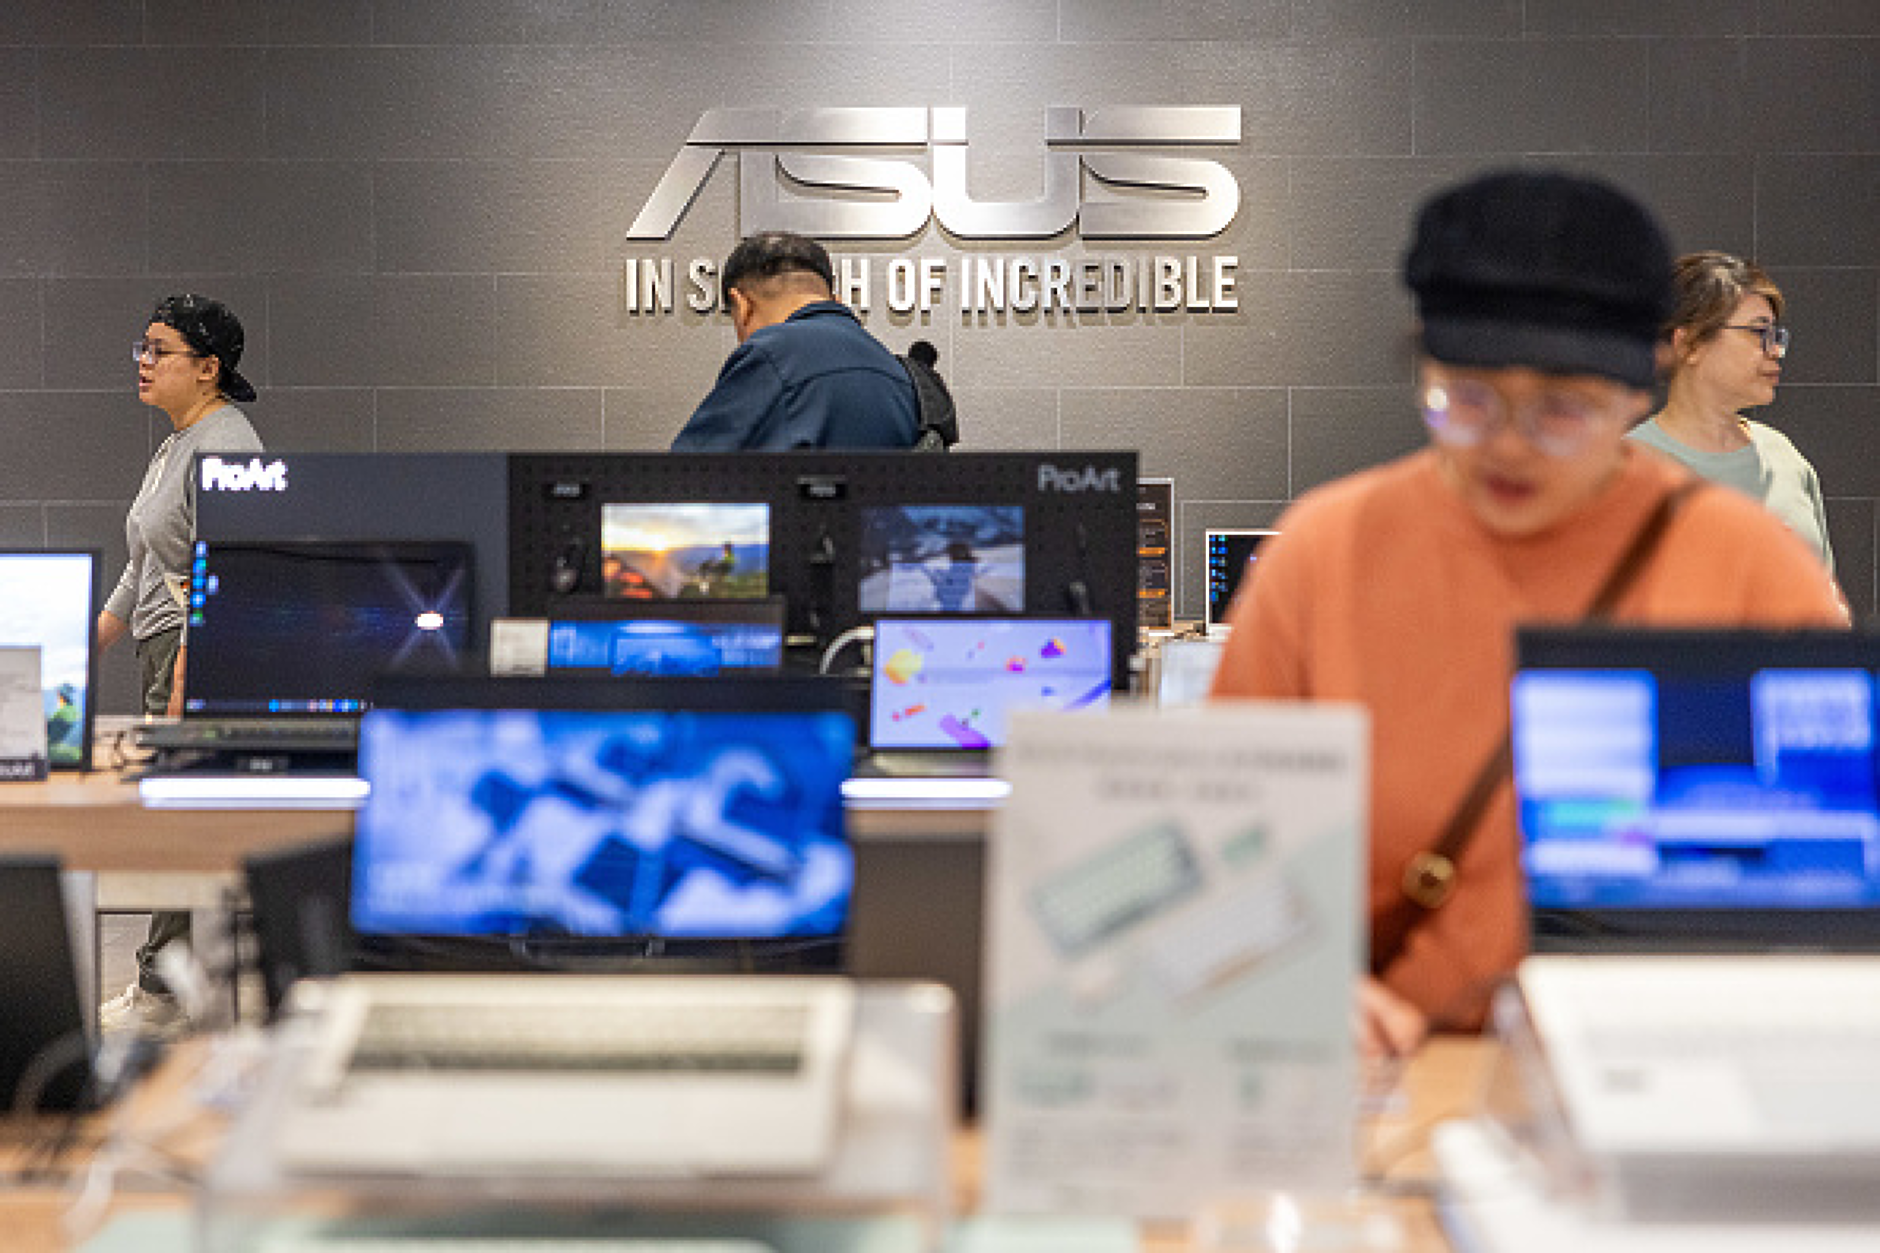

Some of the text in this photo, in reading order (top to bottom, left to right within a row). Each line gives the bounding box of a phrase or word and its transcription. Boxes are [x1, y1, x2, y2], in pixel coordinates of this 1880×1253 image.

[626, 105, 1242, 241] ASUS
[625, 257, 675, 313] IN
[886, 257, 947, 313] OF
[960, 255, 1240, 313] INCREDIBLE
[1037, 463, 1121, 492] ProArt
